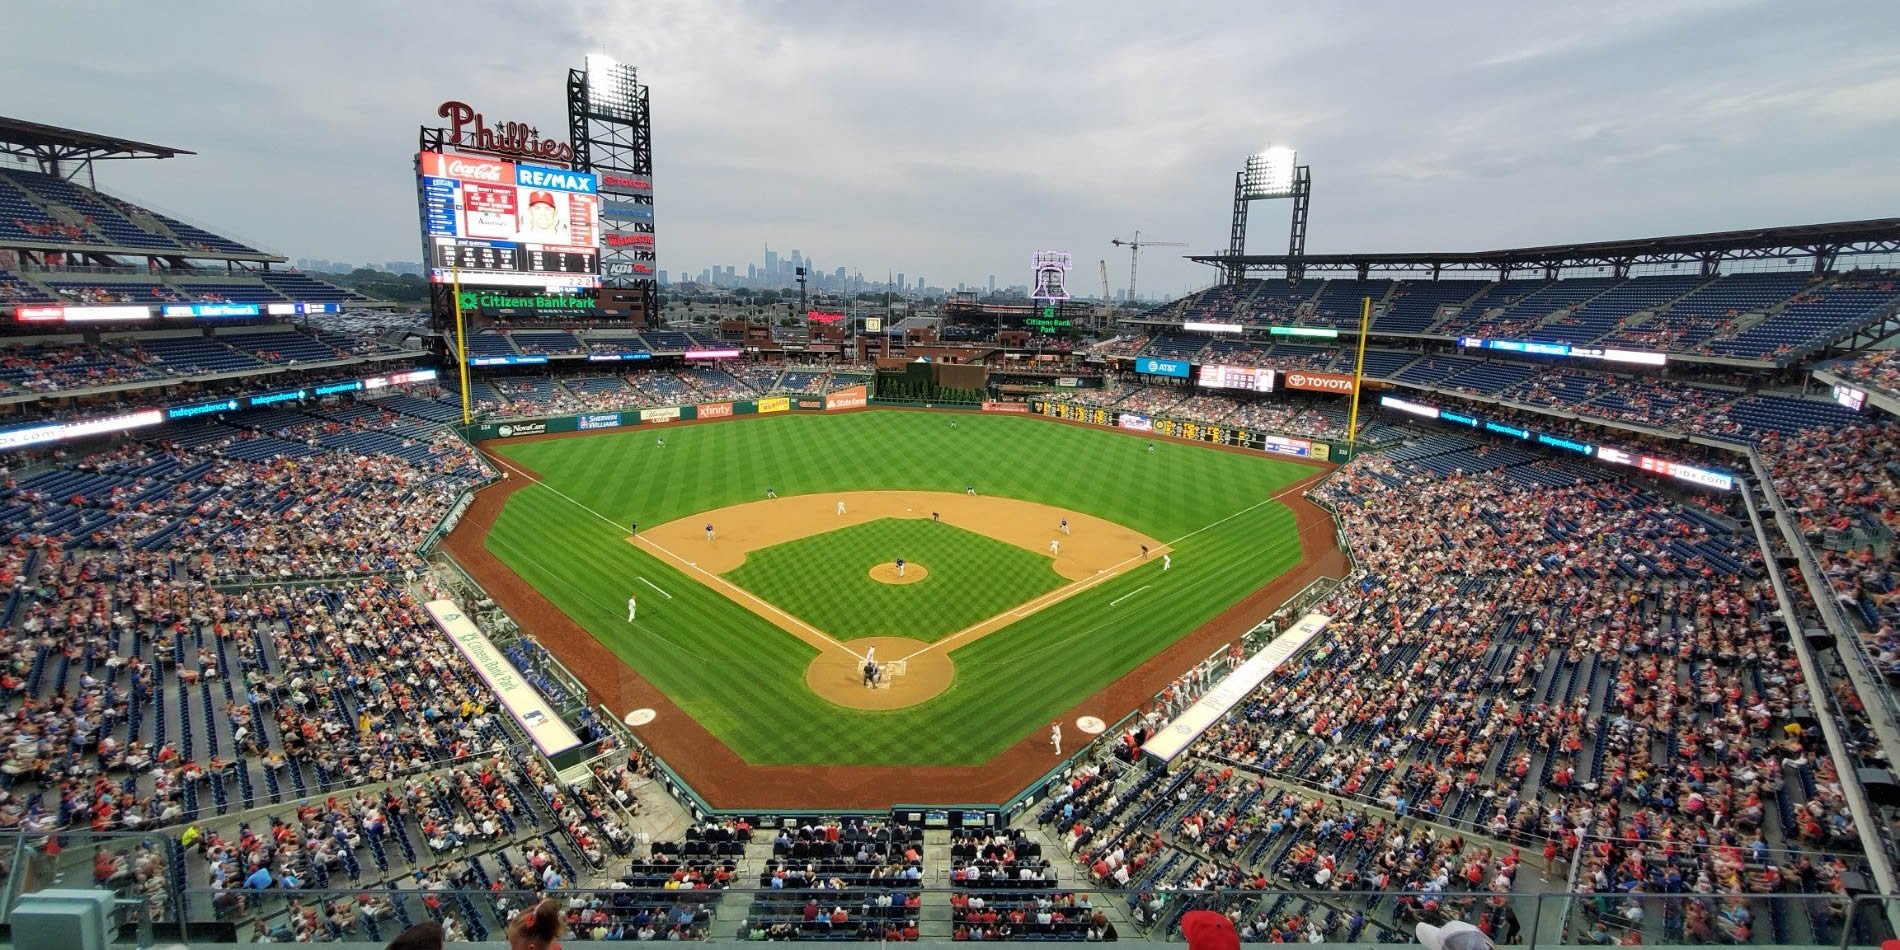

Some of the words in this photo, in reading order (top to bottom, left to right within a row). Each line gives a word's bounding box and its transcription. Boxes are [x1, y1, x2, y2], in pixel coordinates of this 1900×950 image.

[438, 100, 574, 161] Phillies
[519, 169, 592, 192] RE/MAX
[481, 295, 534, 308] Citizens
[536, 296, 567, 308] Bank
[569, 297, 596, 309] Park
[1025, 318, 1053, 326] Citizens
[1158, 363, 1177, 372] AT&T
[316, 383, 355, 395] Independence
[1307, 377, 1352, 390] TOYOTA
[251, 392, 297, 405] Independence
[169, 401, 227, 418] Independence
[700, 403, 731, 417] xfinity
[589, 414, 618, 423] SHERWIN
[512, 423, 546, 432] NovaCare
[1486, 422, 1523, 437] Independence
[1539, 434, 1584, 452] Independence
[484, 660, 508, 678] Bank
[497, 675, 520, 692] Park
